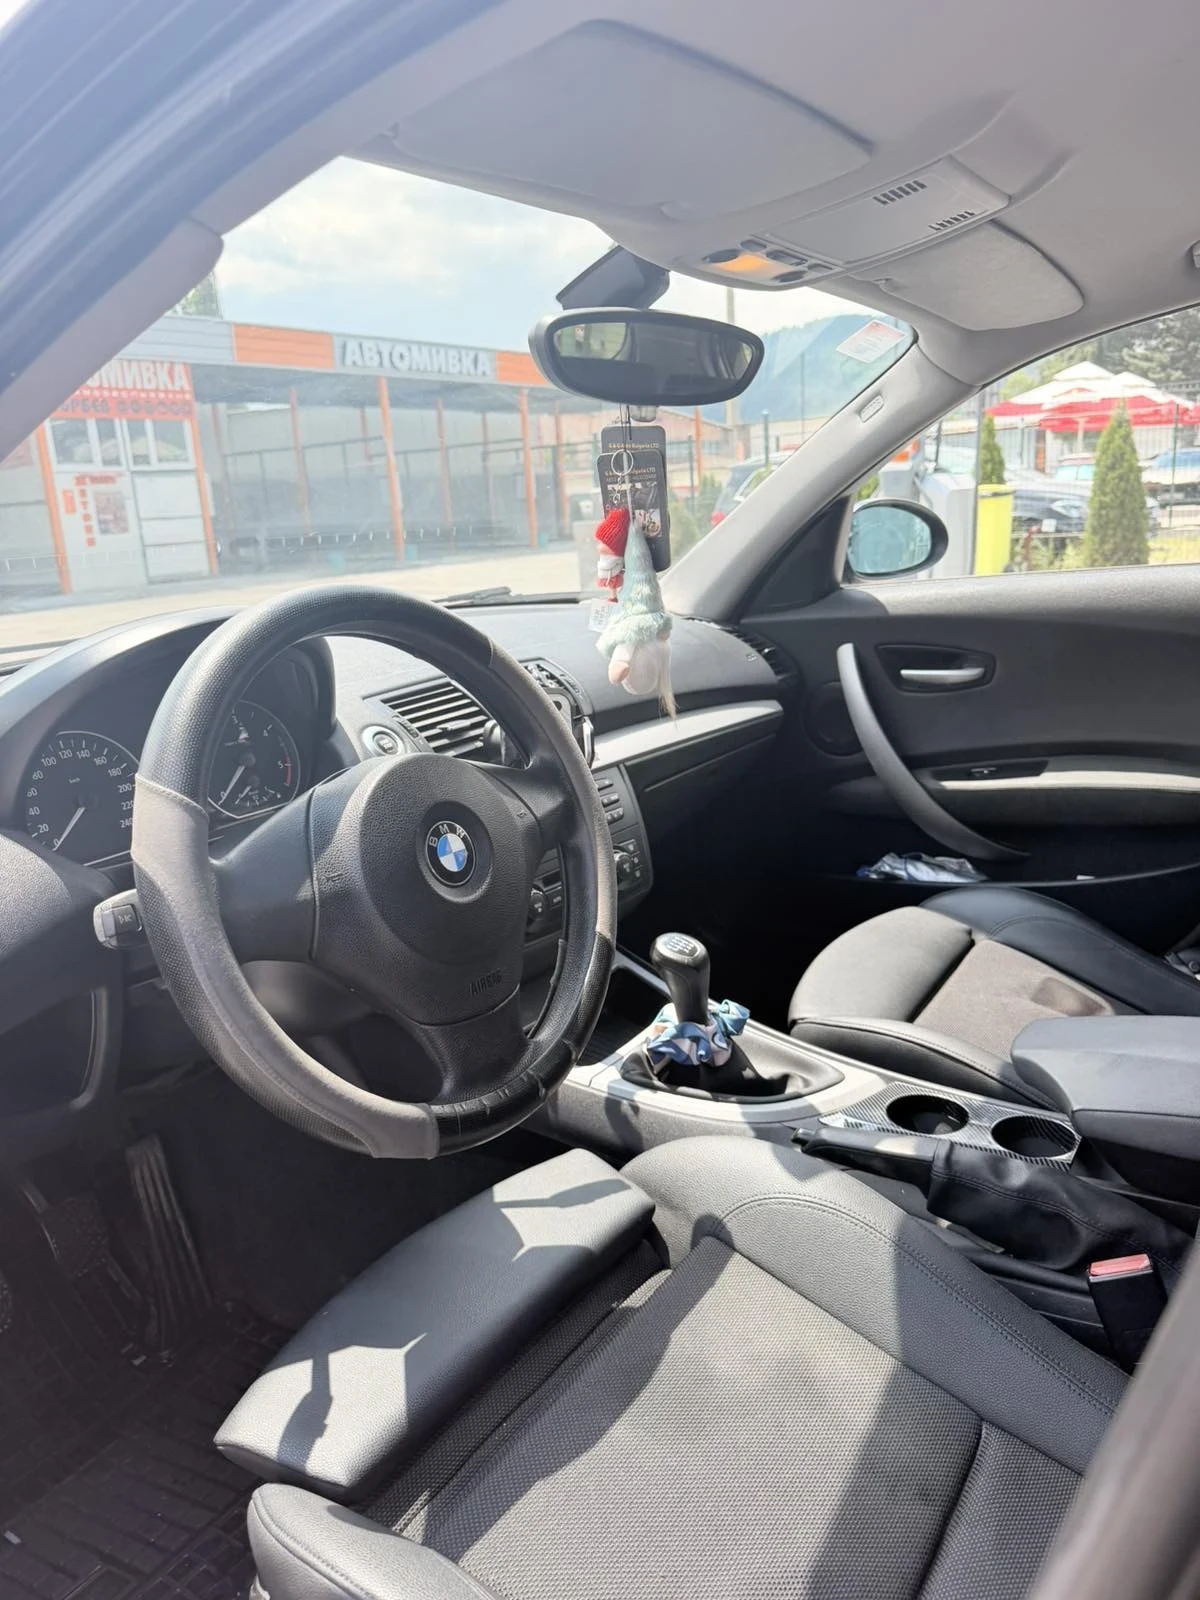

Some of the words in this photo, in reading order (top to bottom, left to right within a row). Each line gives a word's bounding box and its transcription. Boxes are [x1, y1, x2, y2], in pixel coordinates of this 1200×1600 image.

[342, 340, 491, 376] АВТОМИВКА
[59, 749, 73, 760] 120
[76, 749, 90, 760] 140
[41, 756, 57, 767] 100
[93, 756, 107, 766] 160
[277, 760, 284, 769] 5
[107, 767, 122, 777] 180
[27, 787, 38, 798] 60
[117, 783, 132, 793] 200
[28, 806, 40, 816] 40
[37, 823, 49, 833] 20
[429, 824, 466, 848] BMW
